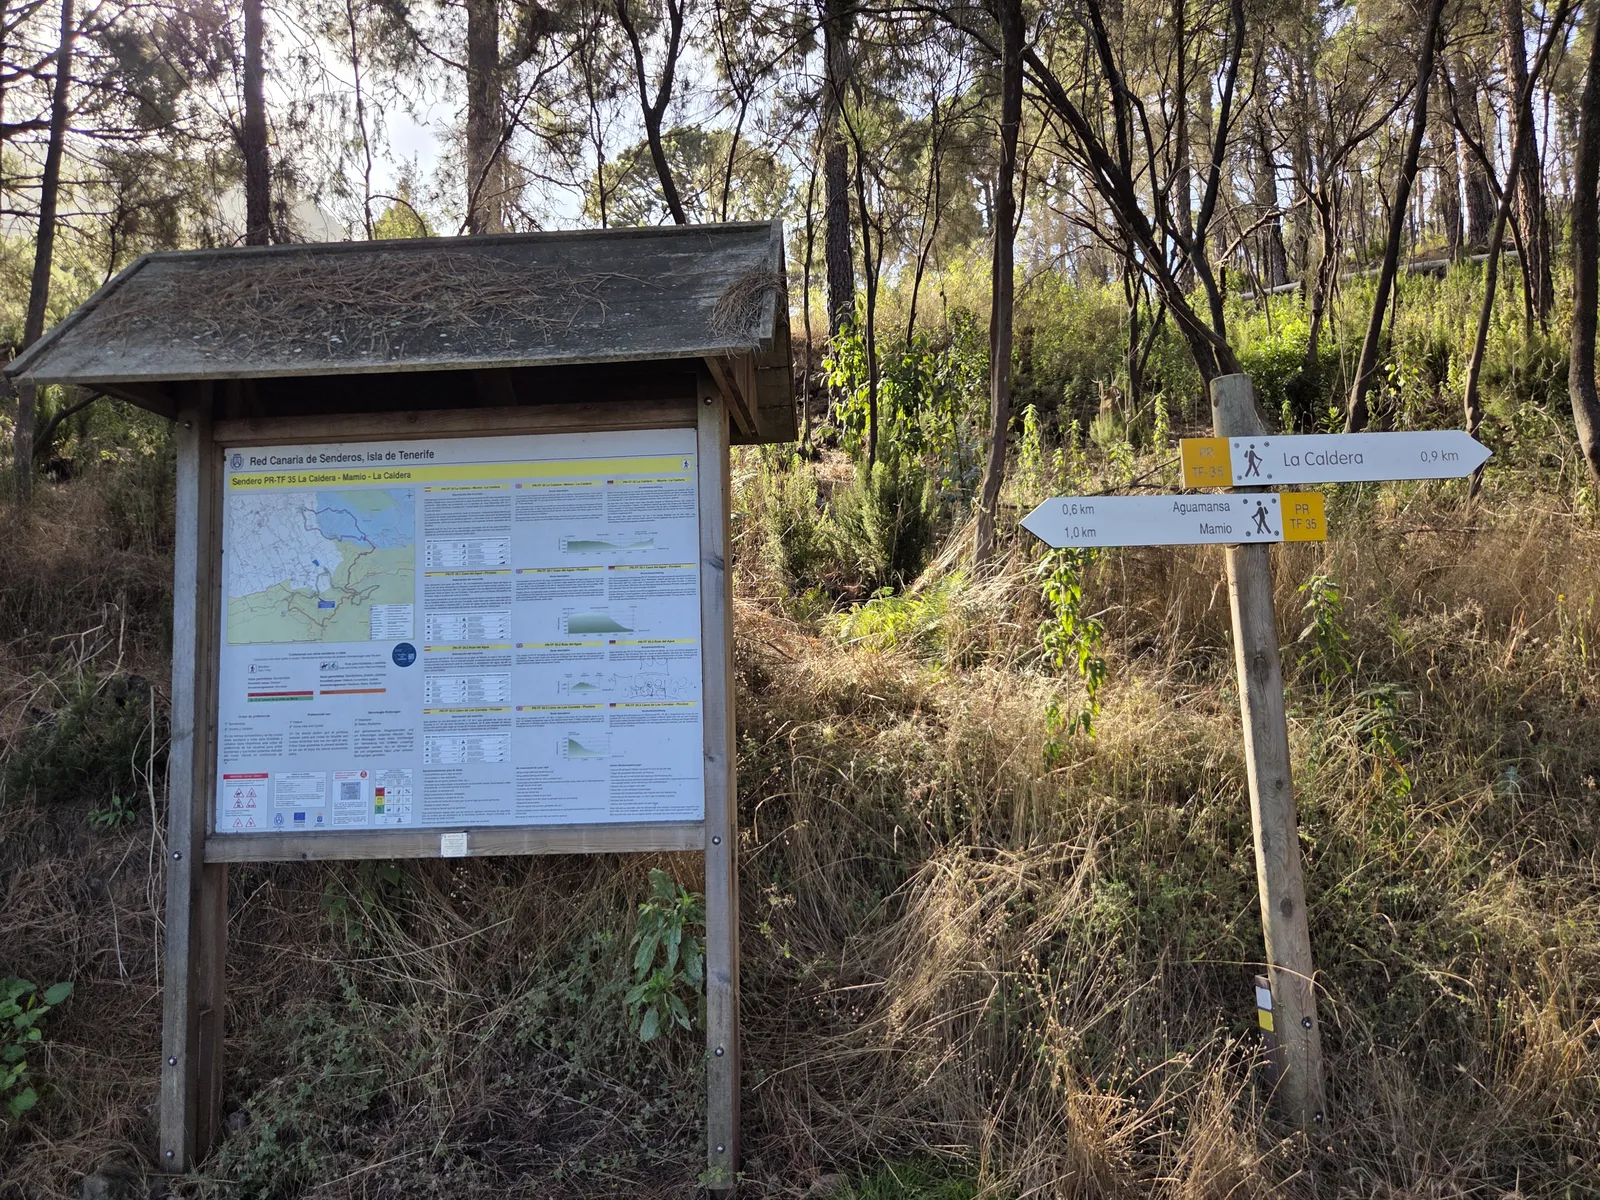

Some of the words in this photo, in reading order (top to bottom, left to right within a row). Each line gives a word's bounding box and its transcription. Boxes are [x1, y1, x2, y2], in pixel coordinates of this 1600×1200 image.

[249, 456, 267, 466] Red
[269, 454, 304, 466] Canaria
[305, 454, 317, 464] de
[319, 452, 365, 464] Senderos,
[385, 451, 396, 460] de
[398, 449, 435, 460] Tenerife
[1283, 452, 1300, 467] La
[1304, 450, 1364, 466] Caldera
[1420, 450, 1438, 464] 0,9
[1441, 449, 1459, 462] km
[232, 477, 262, 486] Sendero
[263, 475, 286, 485] PR-TF
[287, 475, 297, 484] 35
[297, 474, 307, 483] La
[308, 474, 336, 483] Caldera
[372, 472, 382, 480] La
[383, 471, 412, 480] Caldera
[1062, 503, 1078, 516] 0,6
[1079, 503, 1095, 515] km
[1172, 501, 1231, 516] Aguamansa
[1295, 504, 1310, 515] PR
[1199, 523, 1233, 535] Mamio
[1290, 518, 1303, 530] TF
[1305, 518, 1318, 530] 35
[1064, 526, 1080, 540] 1,0
[1081, 526, 1097, 538] km
